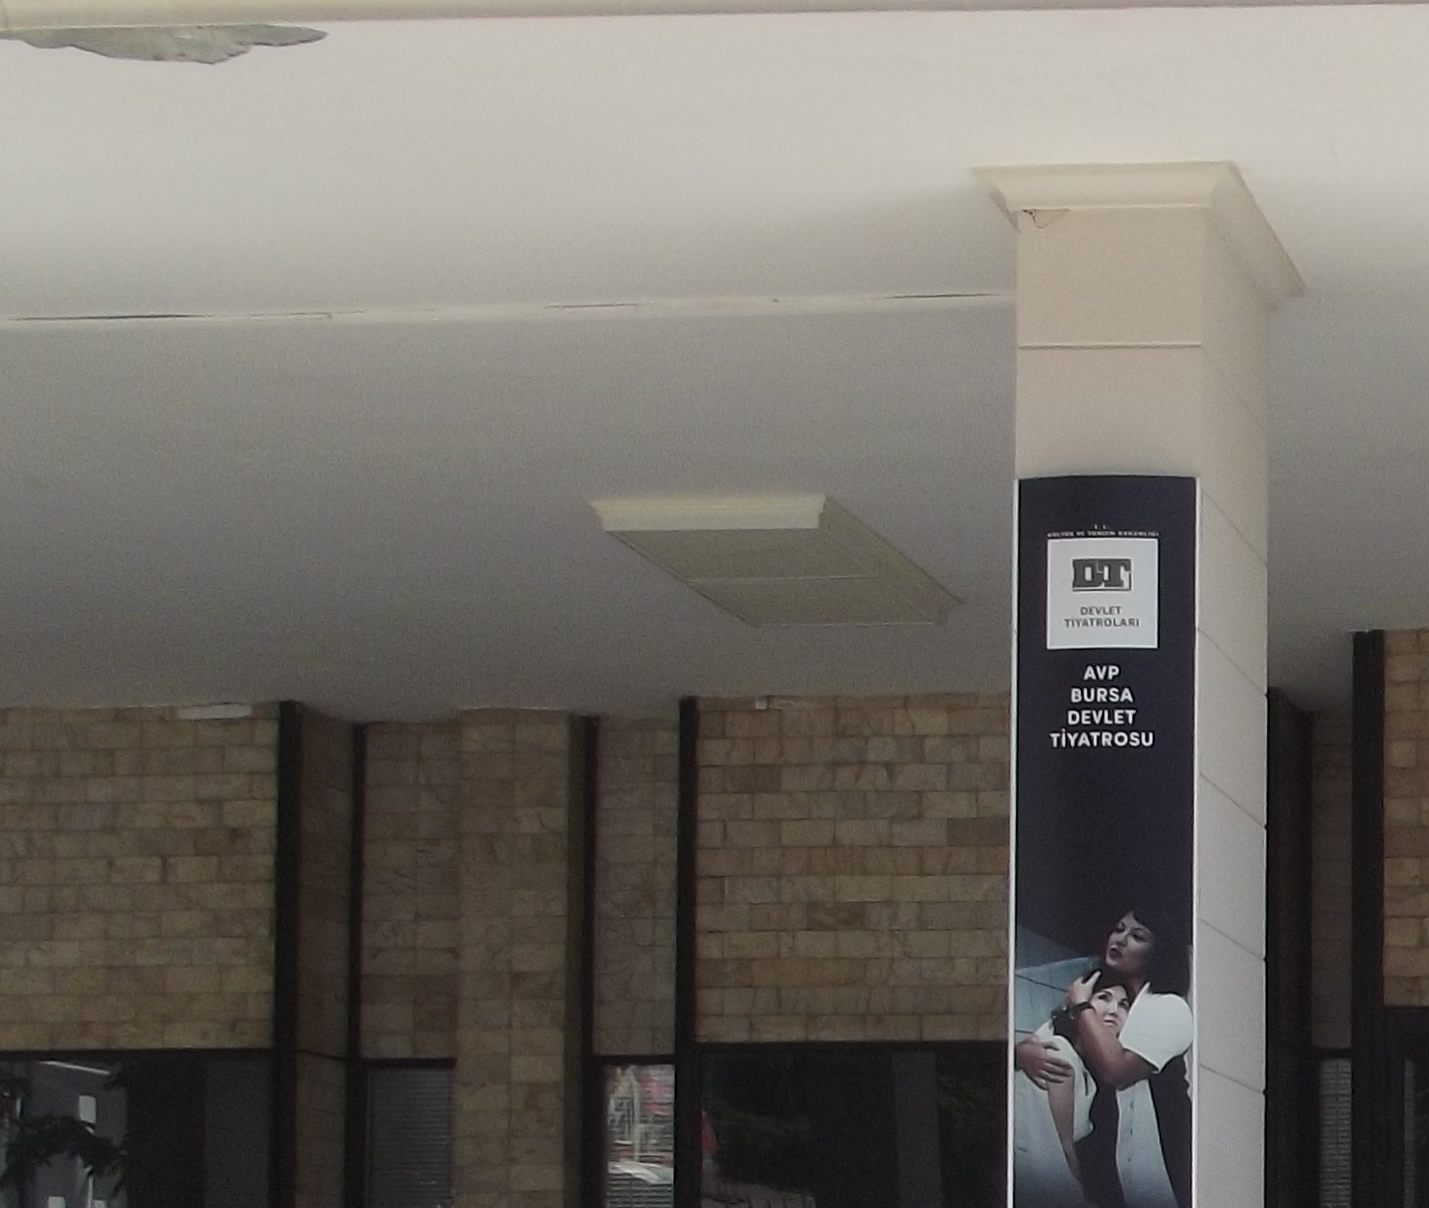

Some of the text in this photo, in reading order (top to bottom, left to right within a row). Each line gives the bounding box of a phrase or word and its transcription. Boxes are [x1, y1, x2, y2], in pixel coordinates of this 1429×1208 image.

[1080, 606, 1121, 615] DEVLET
[1065, 617, 1140, 627] TİYATROLARI
[1084, 665, 1120, 681] AVP
[1071, 687, 1133, 703] BURSA
[1068, 709, 1136, 725] DEVLET
[1050, 728, 1154, 748] TİYATROSU
